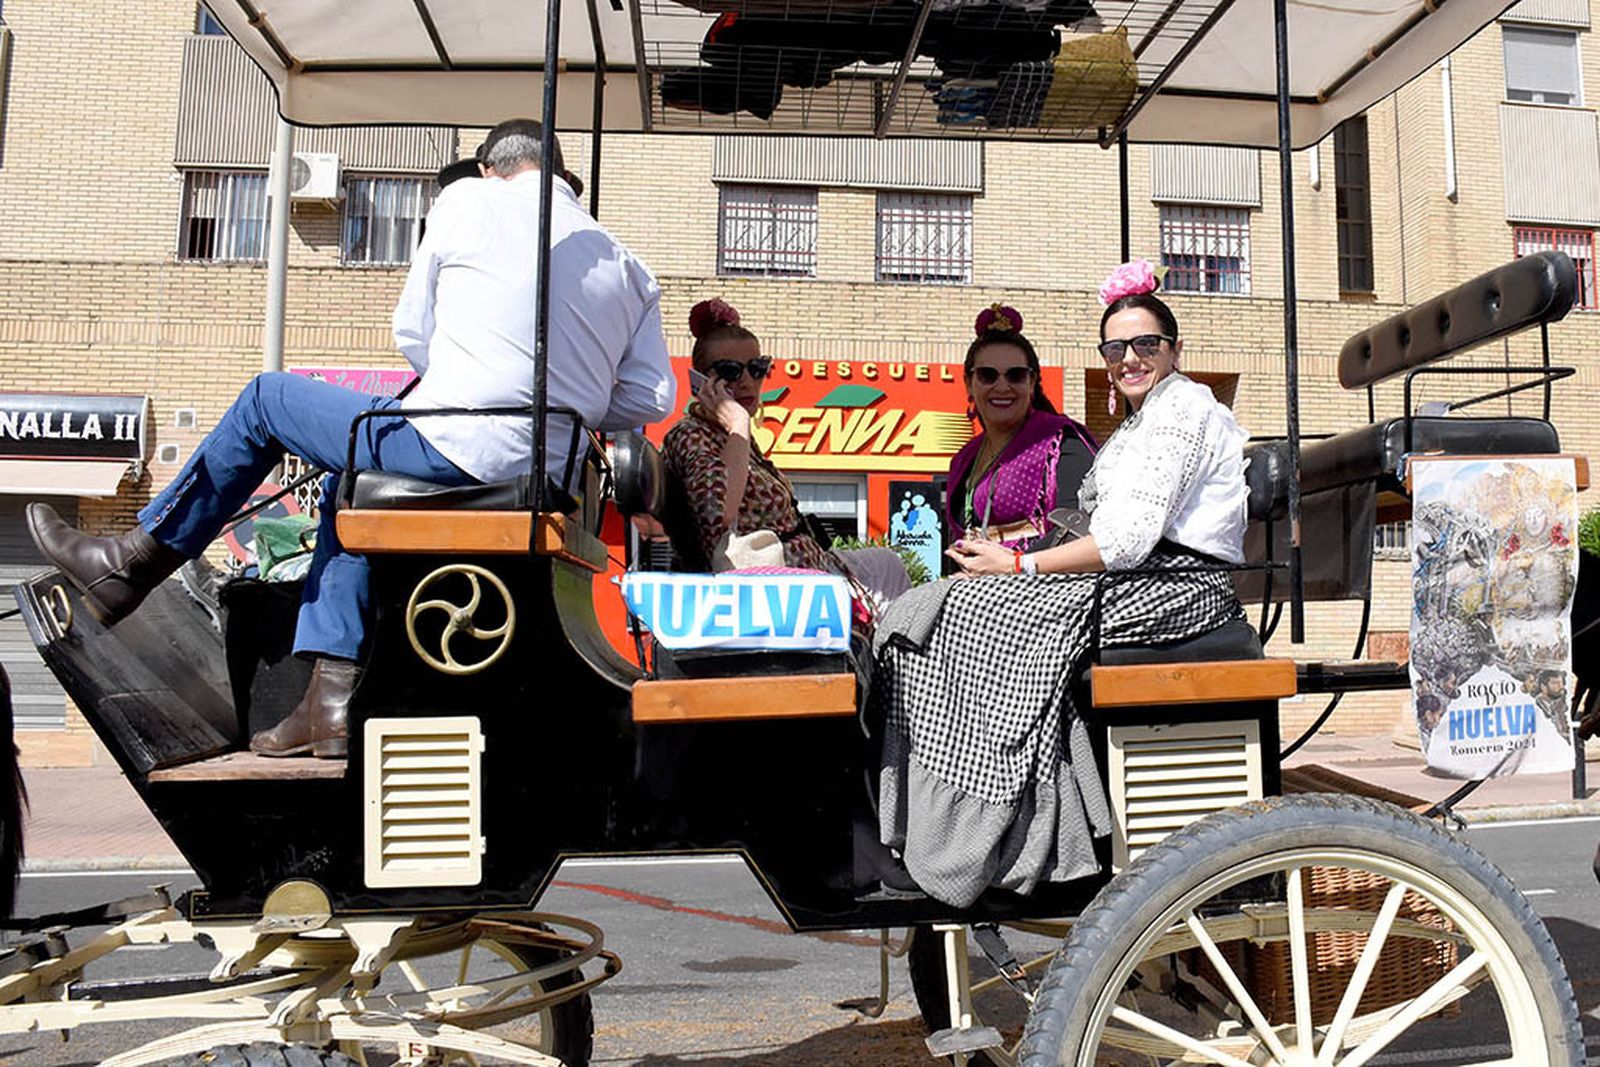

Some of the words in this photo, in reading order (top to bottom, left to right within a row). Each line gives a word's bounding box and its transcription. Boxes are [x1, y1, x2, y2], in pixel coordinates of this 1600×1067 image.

[0, 411, 104, 440] NALLA
[113, 413, 138, 440] II
[626, 583, 844, 637] HUELVA
[1449, 704, 1536, 740] HUELVA
